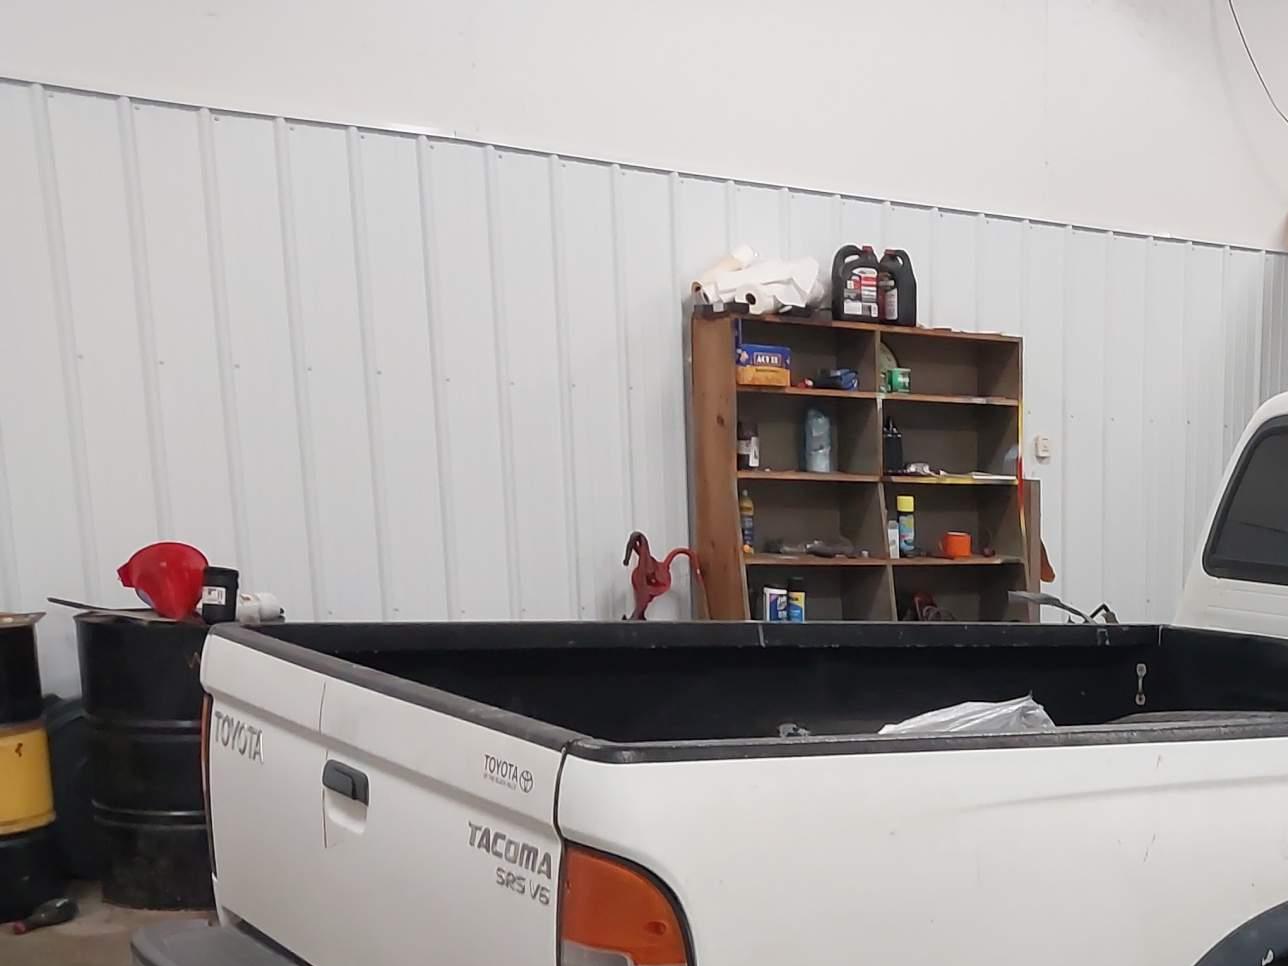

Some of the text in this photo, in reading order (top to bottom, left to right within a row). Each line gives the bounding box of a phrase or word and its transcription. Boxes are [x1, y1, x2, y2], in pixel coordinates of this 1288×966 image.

[214, 710, 265, 765] TOYOTA
[484, 754, 518, 782] TOYOTA
[468, 820, 552, 880] TACOMA
[529, 879, 550, 905] V6
